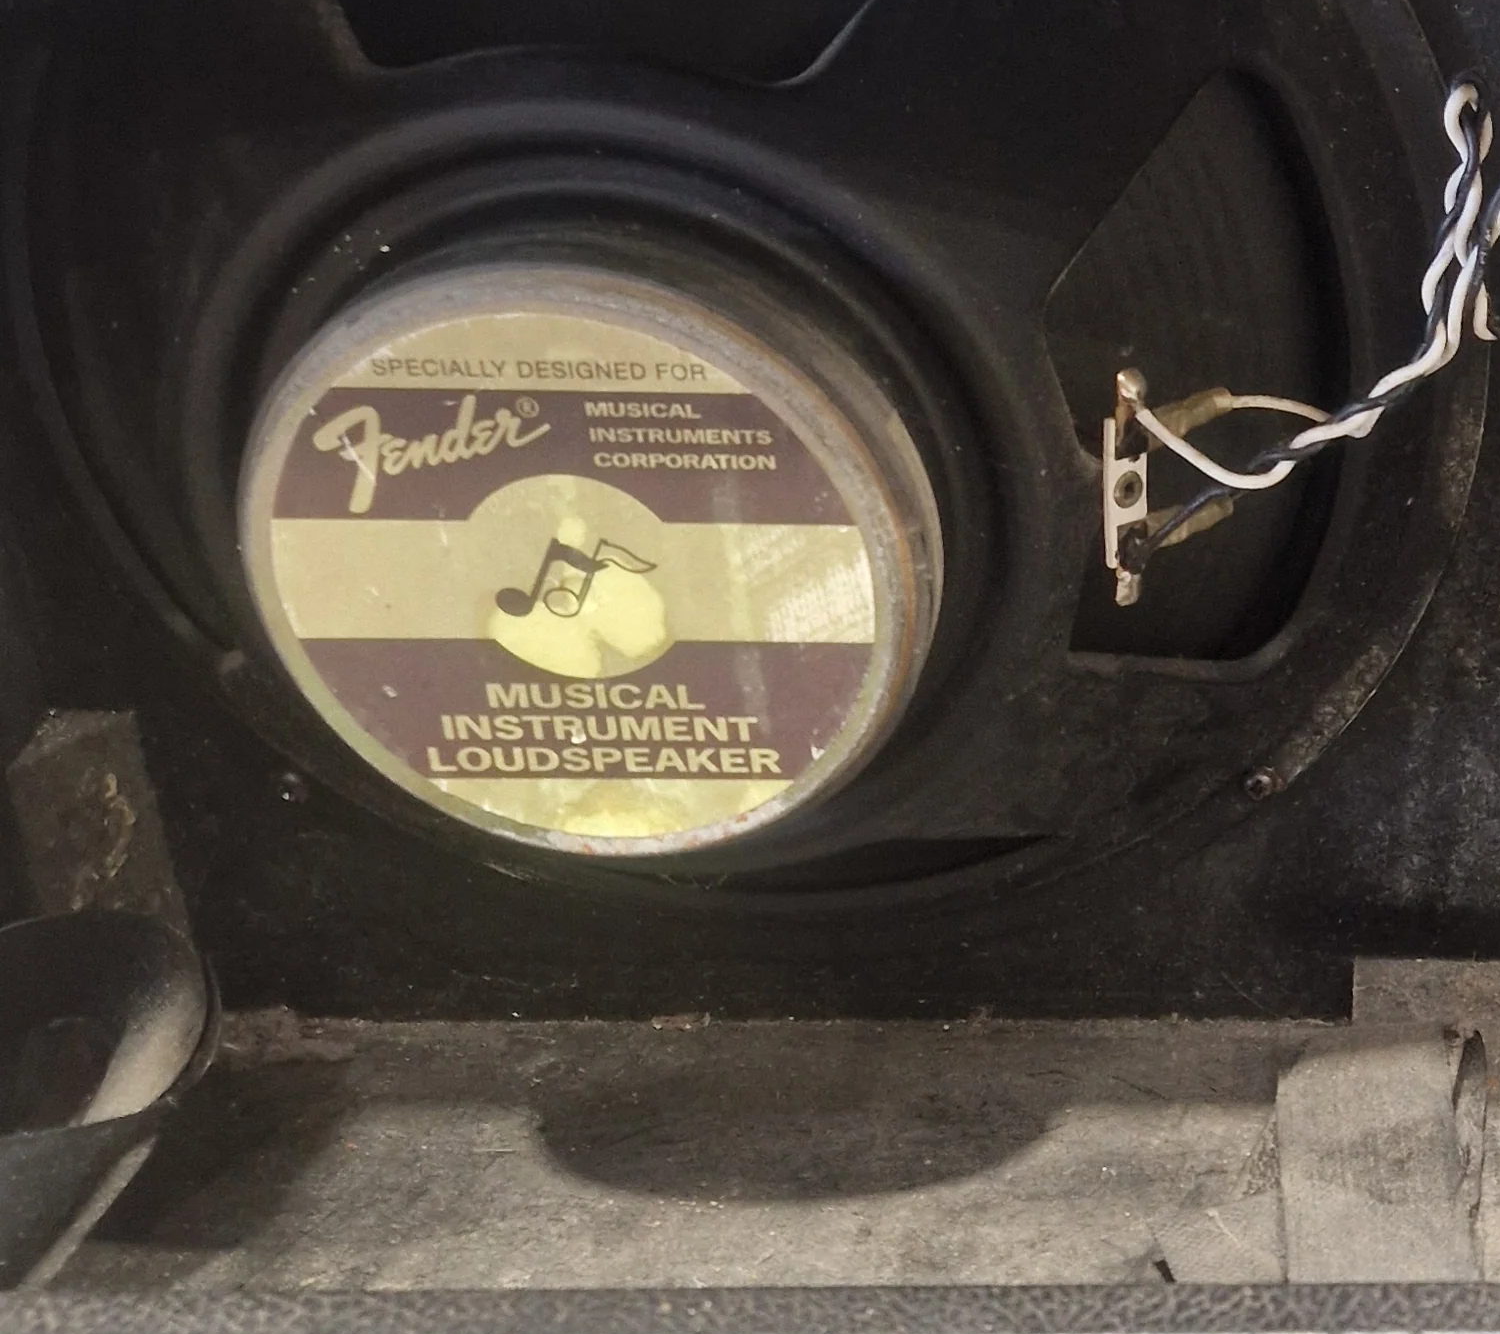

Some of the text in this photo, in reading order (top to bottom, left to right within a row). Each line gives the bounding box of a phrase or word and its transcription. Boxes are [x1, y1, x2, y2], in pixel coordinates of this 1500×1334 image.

[371, 357, 708, 382] SPECIALLY DESIGNED FOR
[584, 401, 703, 420] MUSICAL
[588, 426, 774, 446] INSTRUMENTS
[593, 451, 778, 471] CORPORATION
[484, 681, 707, 710] MUSICAL
[439, 713, 759, 742] INSTRUMENT
[427, 745, 783, 775] LOUDSPEAKER
